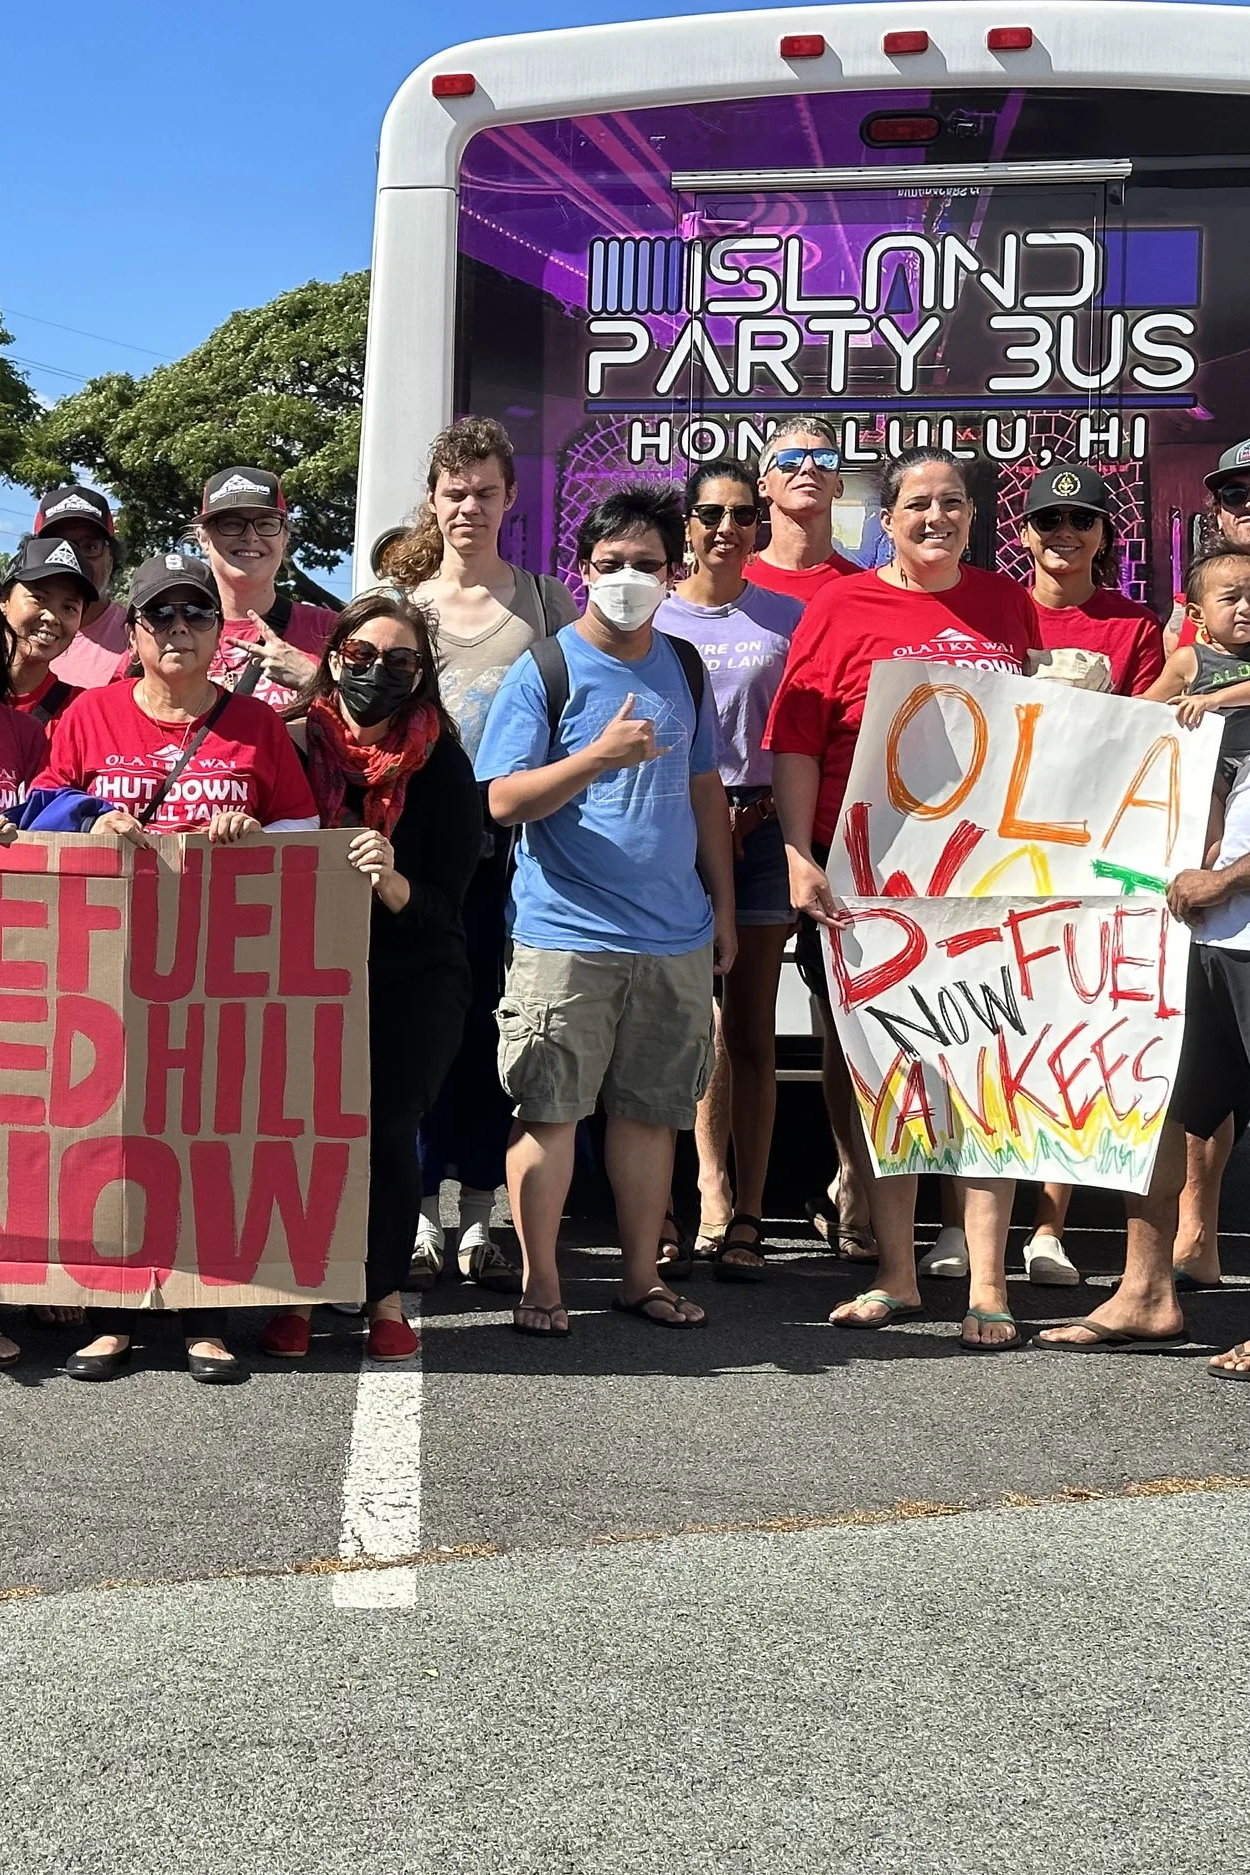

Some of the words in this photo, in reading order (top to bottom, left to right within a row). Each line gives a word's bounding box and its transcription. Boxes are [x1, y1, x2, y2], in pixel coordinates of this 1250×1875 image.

[691, 232, 1100, 312] ISLAND
[588, 316, 940, 394] PARTY
[988, 313, 1196, 391] BUS
[631, 416, 1052, 467] HONLULU,
[1078, 416, 1146, 459] HI
[727, 655, 775, 669] LAND
[734, 641, 762, 653] ON
[892, 644, 934, 657] OLA
[949, 642, 977, 652] KA
[95, 775, 158, 799] SHUT
[105, 754, 145, 767] OLA
[198, 758, 237, 769] WAI
[887, 683, 1182, 867] OLA
[863, 963, 1028, 1064] NOW
[143, 1001, 368, 1139] HILL
[845, 1015, 1171, 1155] YANKEES
